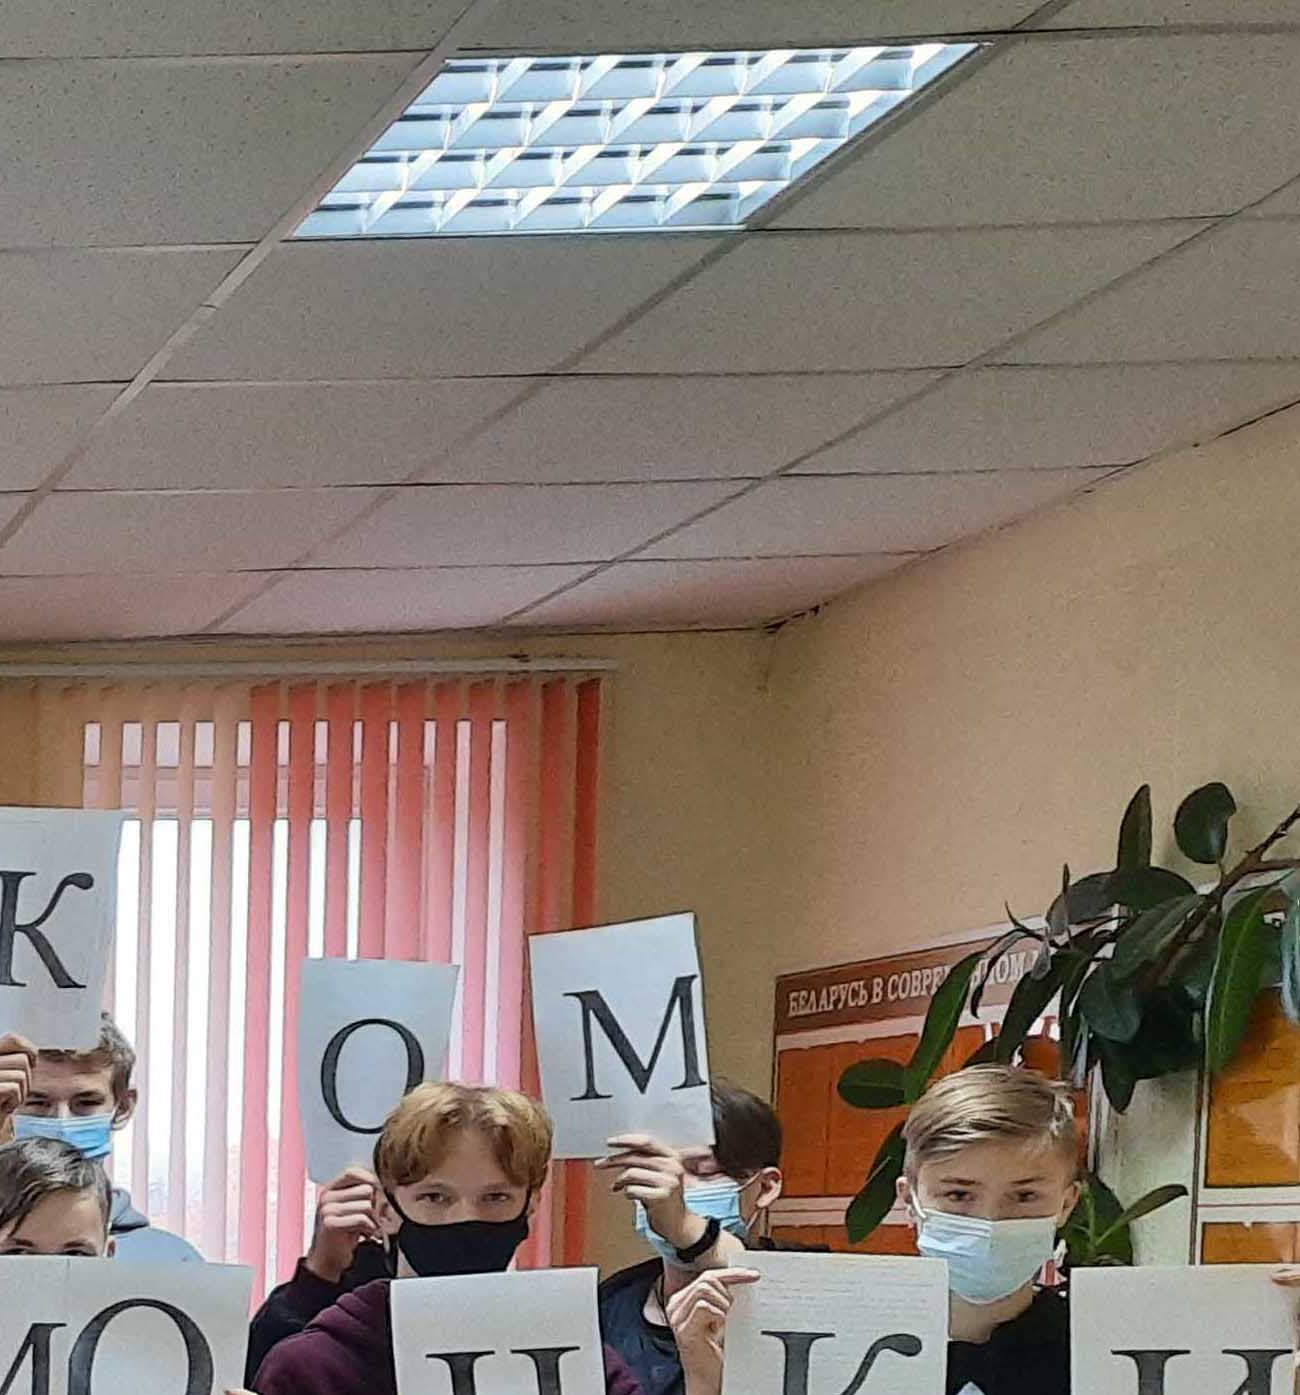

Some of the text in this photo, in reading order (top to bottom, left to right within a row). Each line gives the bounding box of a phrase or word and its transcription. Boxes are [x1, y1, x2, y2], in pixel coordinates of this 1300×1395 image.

[787, 981, 868, 1017] БЕЛАРУСЬ
[870, 976, 883, 1004] В
[320, 1019, 425, 1135] О
[563, 974, 707, 1101] М
